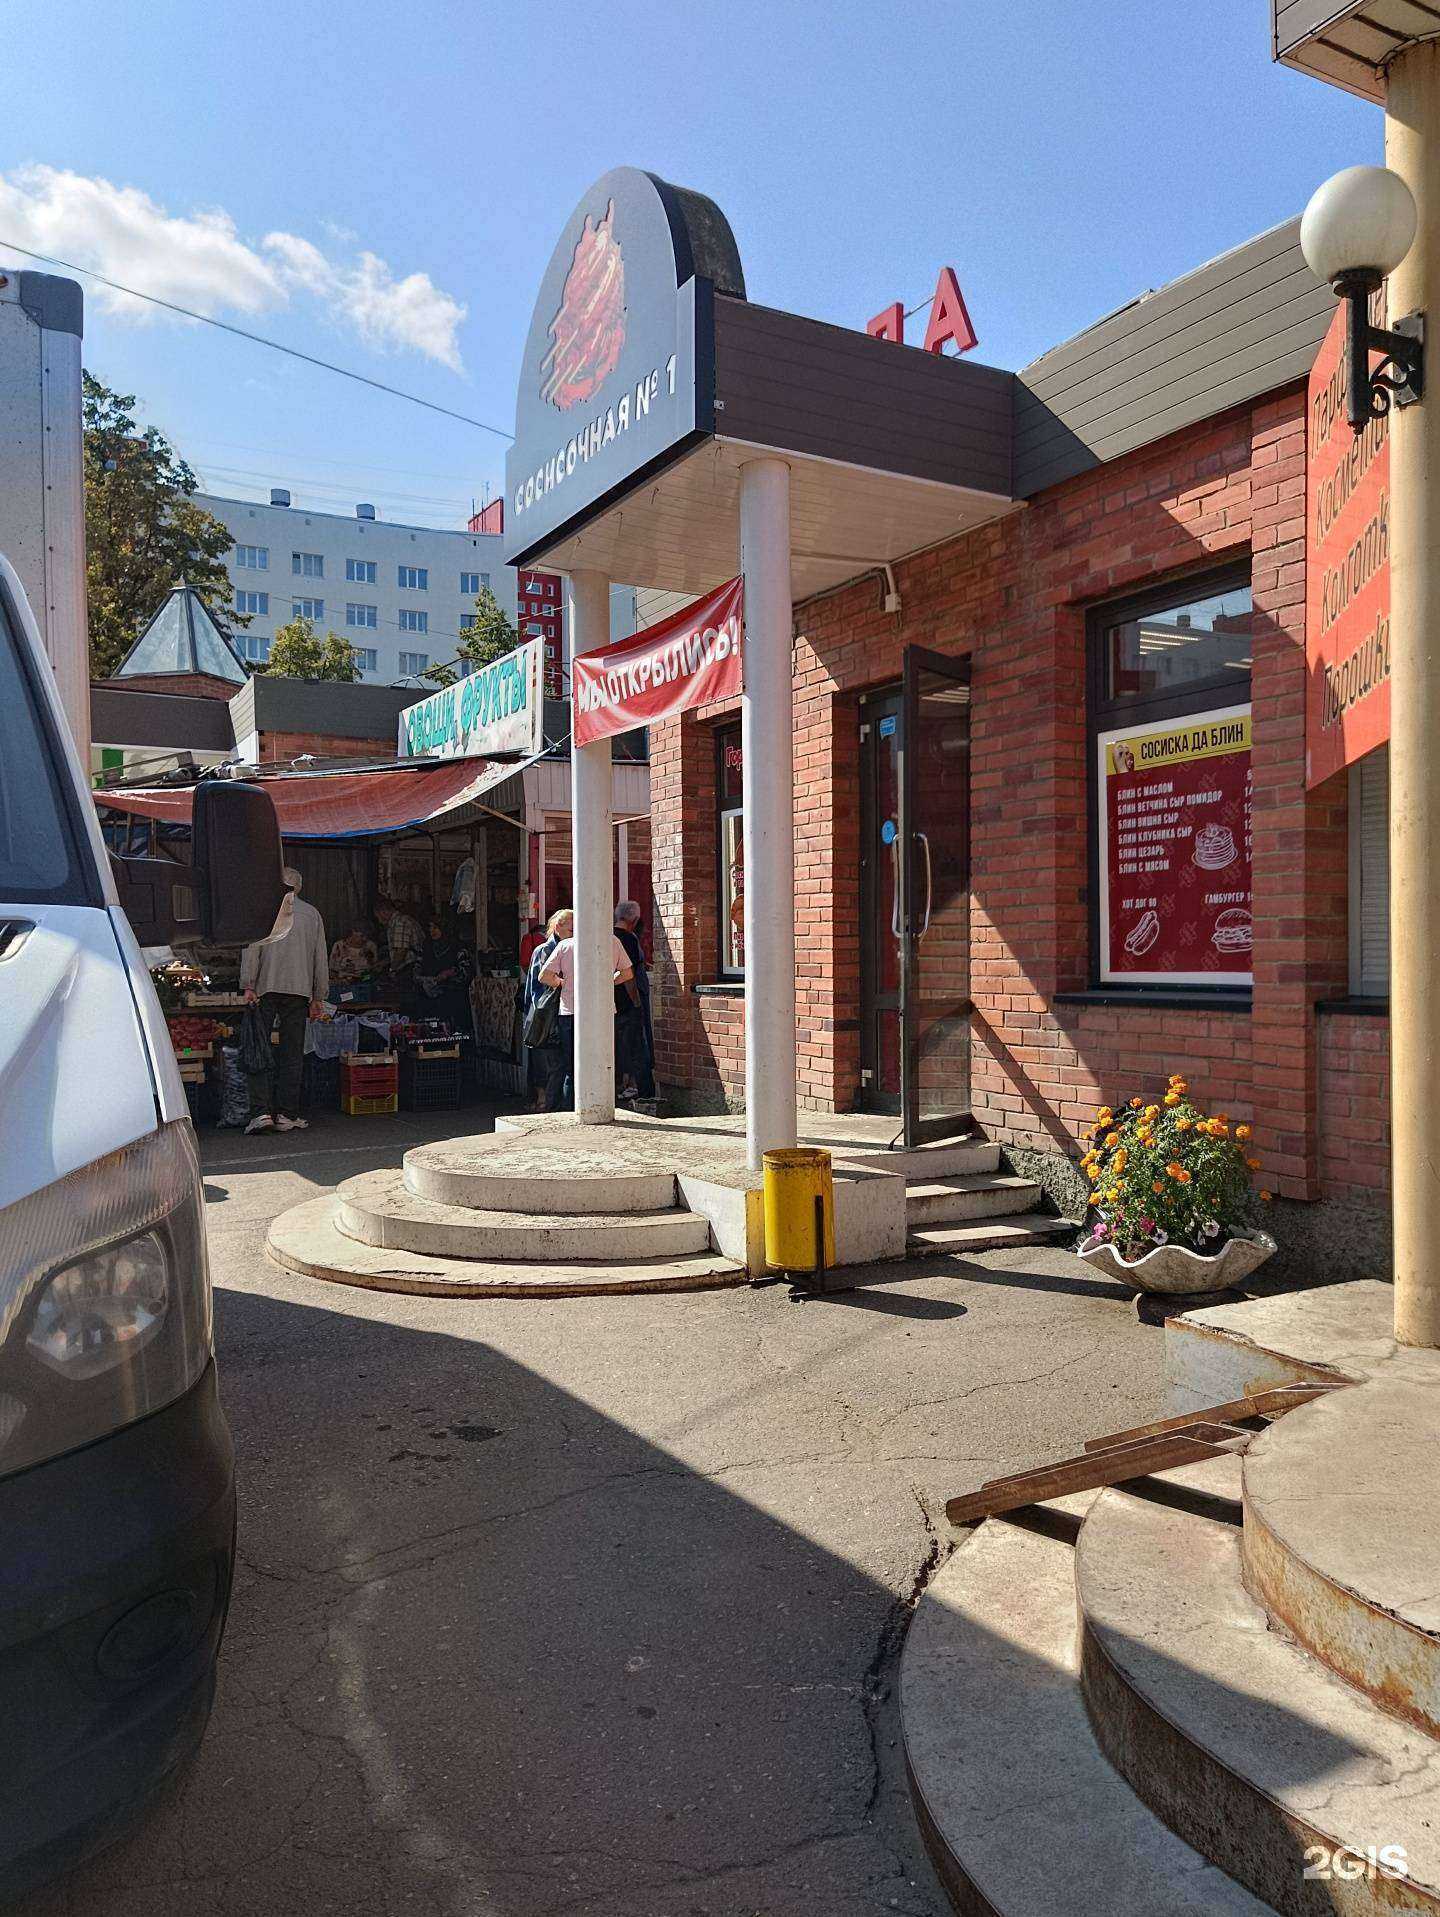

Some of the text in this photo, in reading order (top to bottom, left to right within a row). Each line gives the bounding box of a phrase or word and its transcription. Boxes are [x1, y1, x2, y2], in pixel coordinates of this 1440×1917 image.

[514, 393, 630, 517] СОСИСОЧНАЯ
[577, 615, 738, 715] МЫ ОТКРЫЛИСЬ!
[461, 649, 528, 736] ФРУКТЫ
[1141, 723, 1243, 760] СОСИСКА ДА БЛИН
[1117, 788, 1136, 800] БЛИН
[1143, 782, 1173, 796] МАСЛОМ
[1118, 790, 1223, 815] БЛИН ВЕТЧИНА СЫР ПОМИДОР
[1118, 818, 1136, 830] БЛИН
[1164, 812, 1179, 823] СЫР
[1118, 826, 1193, 845] БЛИН КЛУБНИКА СЫР
[1118, 845, 1165, 860] БЛИН ЦЕЗАРЬ
[1119, 863, 1137, 874] БЛИН
[1145, 860, 1169, 872] МЯСОМ
[1122, 899, 1134, 909] ХОТ
[1135, 898, 1147, 909] ДОГ
